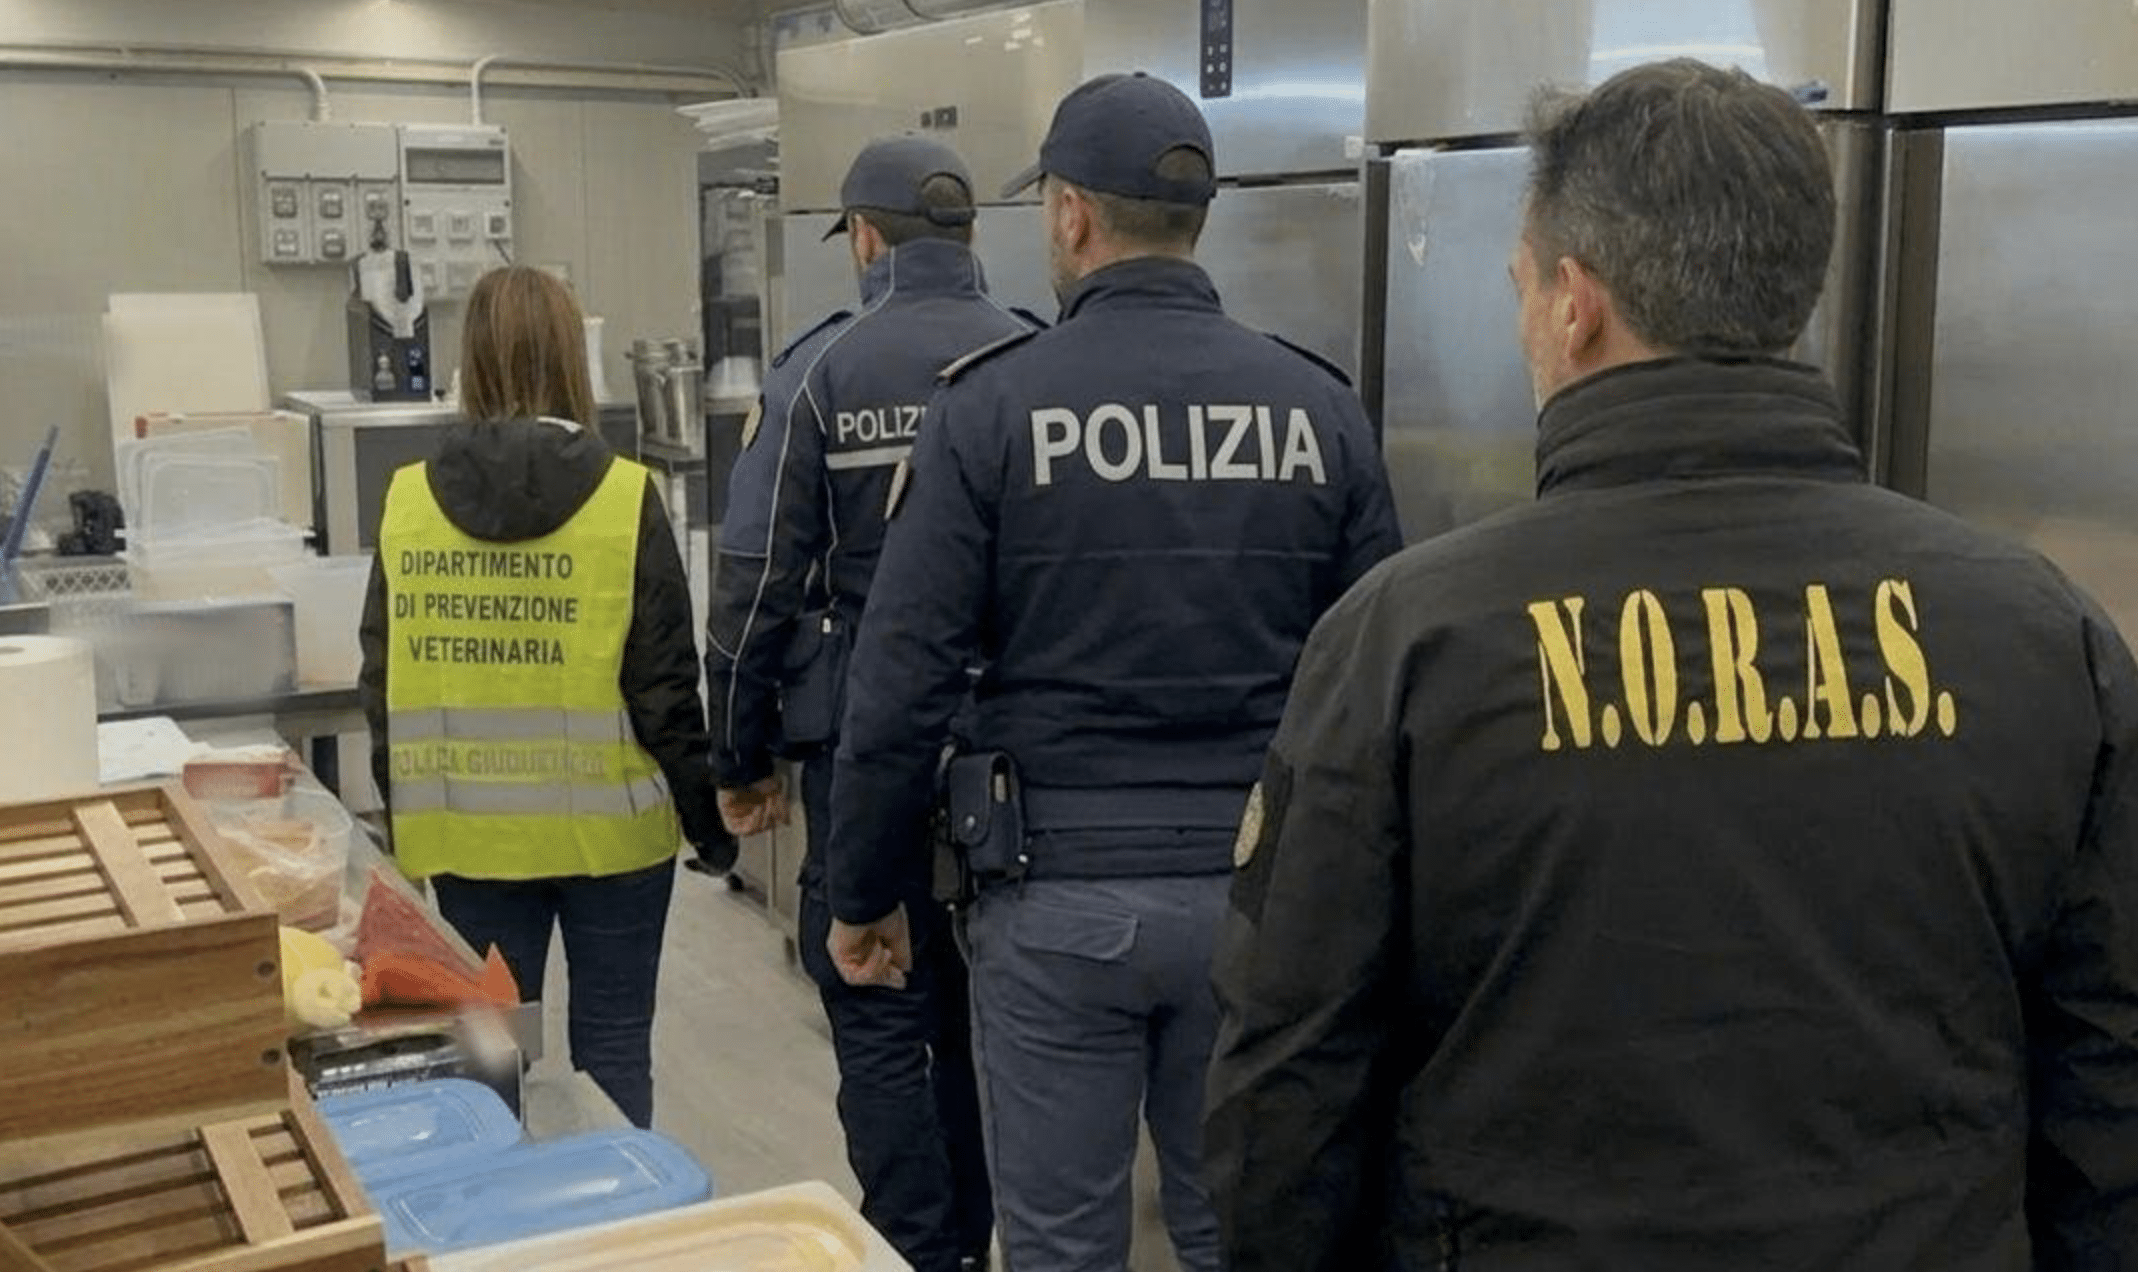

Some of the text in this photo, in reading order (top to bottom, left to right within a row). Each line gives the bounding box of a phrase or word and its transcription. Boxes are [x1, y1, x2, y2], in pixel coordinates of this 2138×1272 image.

[1030, 404, 1327, 485] POLIZIA
[400, 550, 573, 579] DIPARTIMENTO
[394, 593, 579, 624] DI PREVENZIONE
[407, 635, 565, 665] VETERINARIA
[1527, 579, 1957, 751] N.O.R.A.S.
